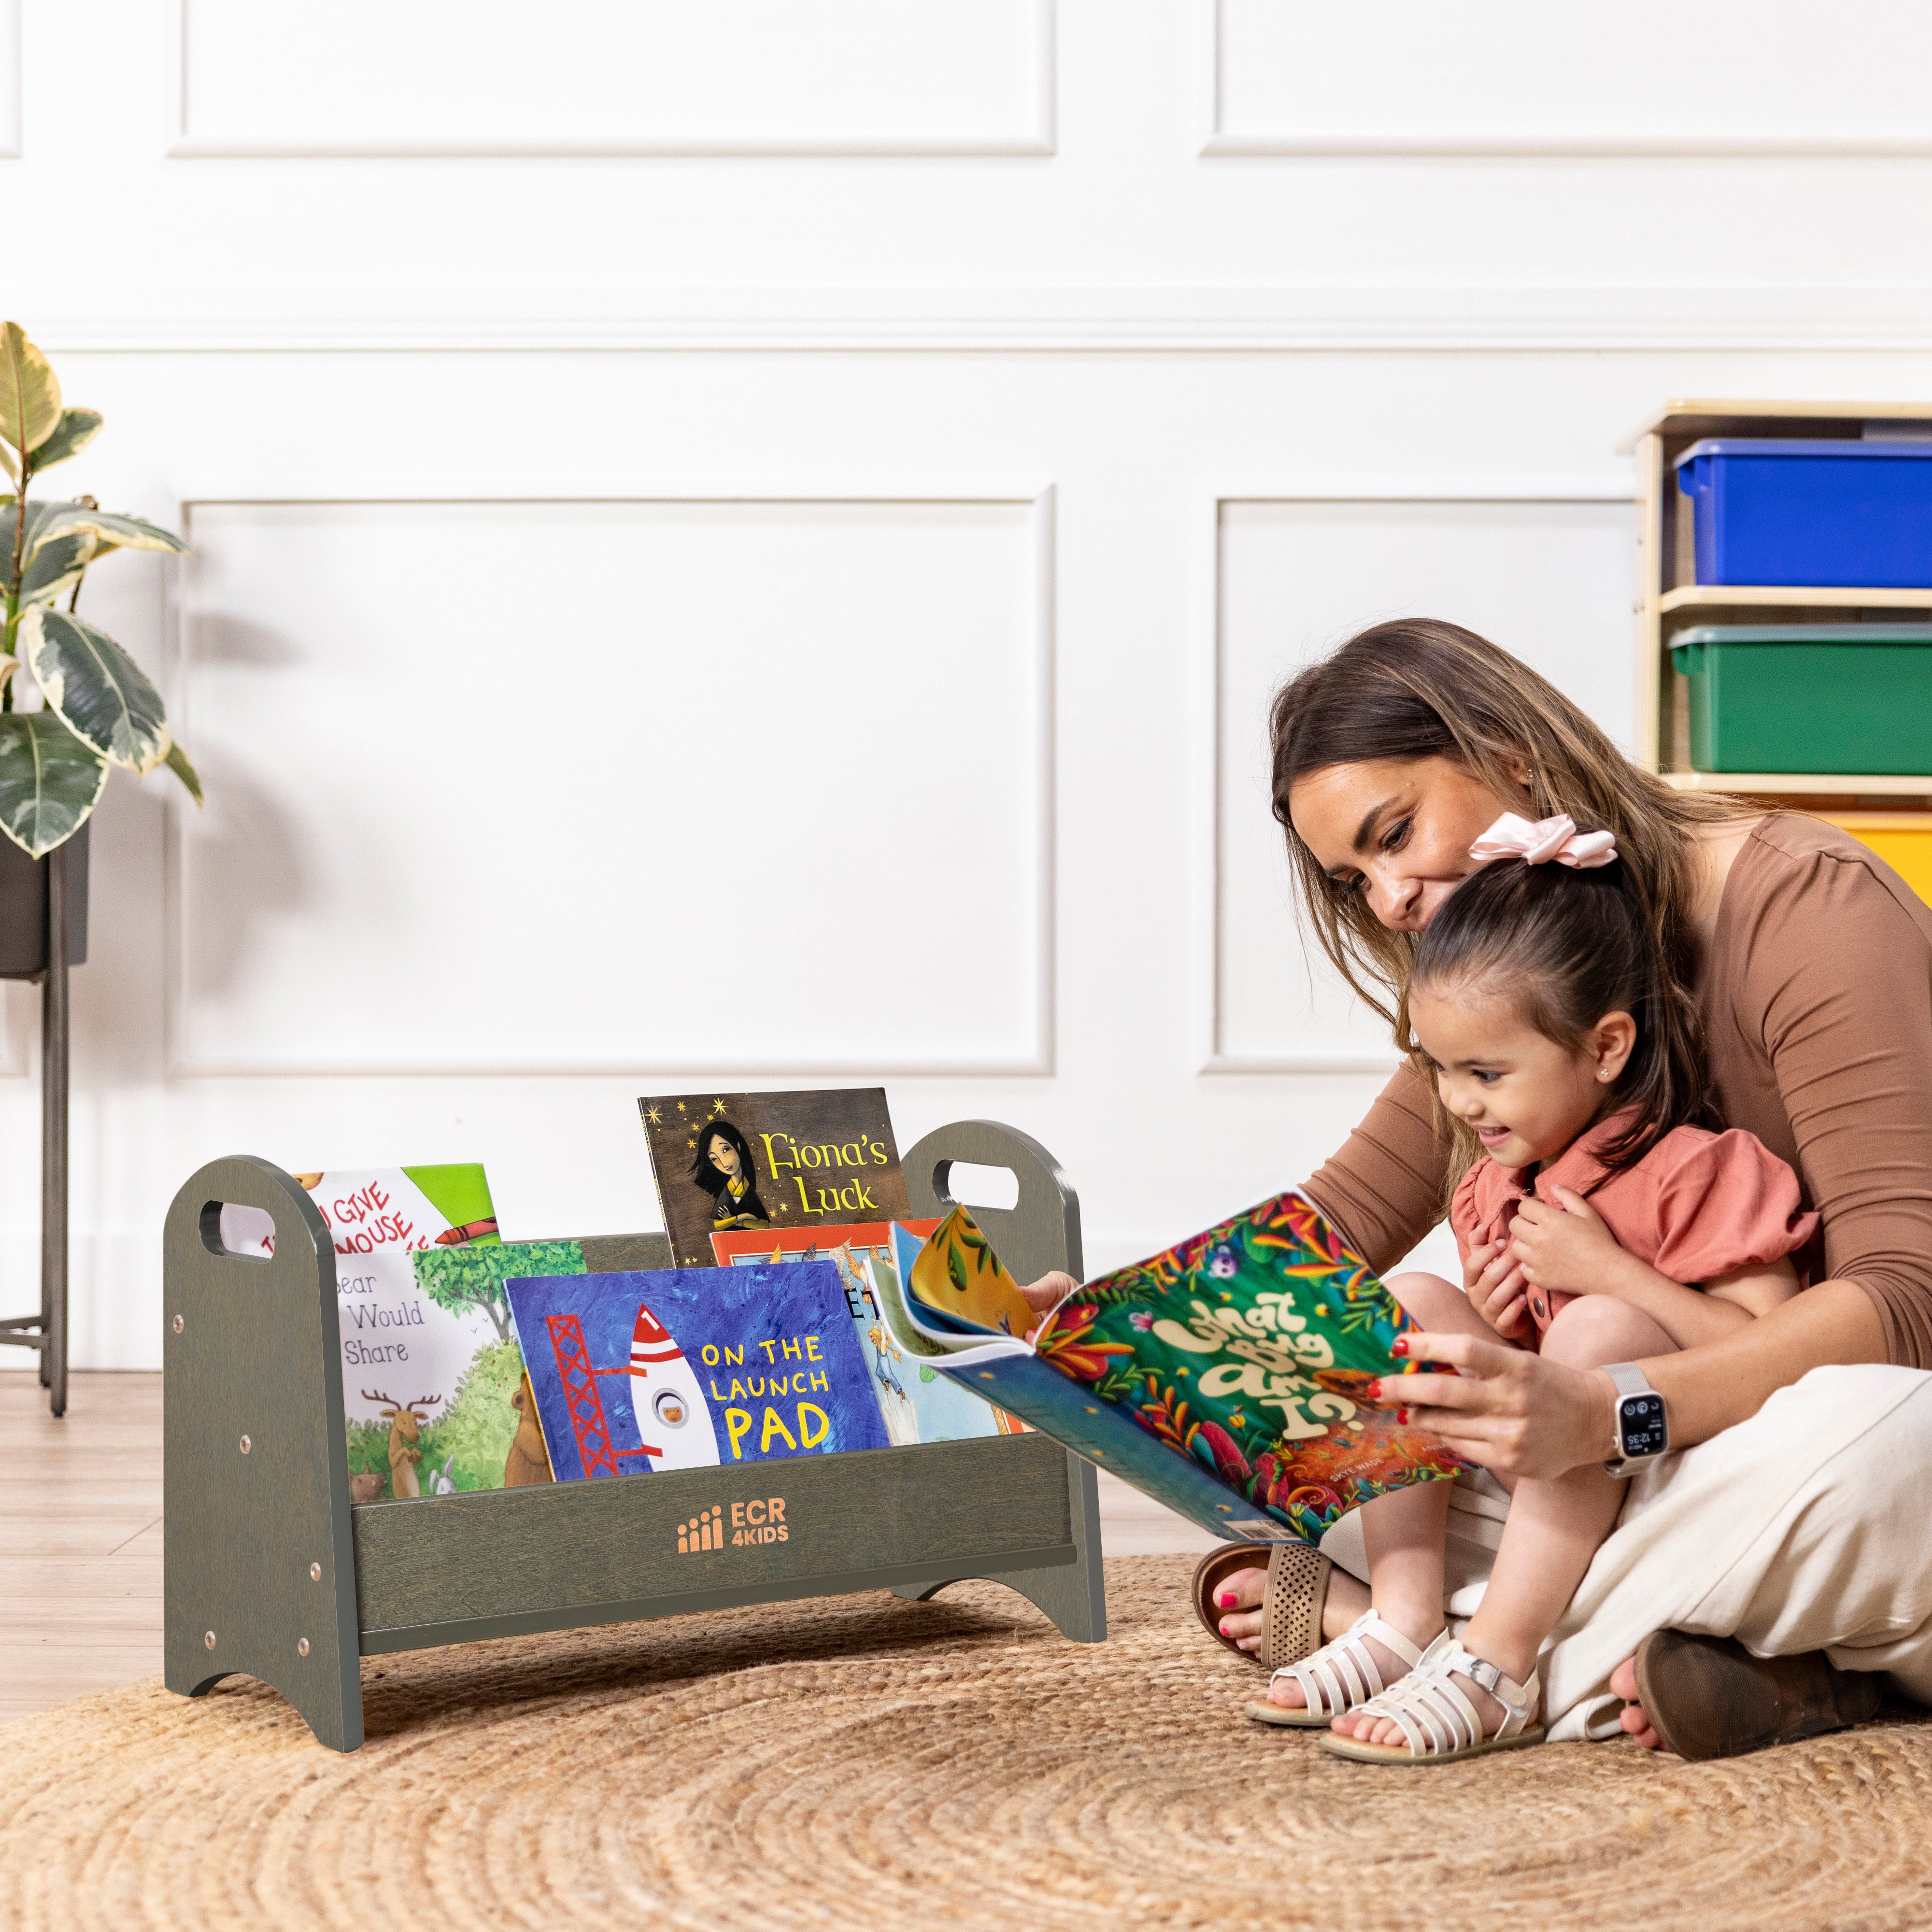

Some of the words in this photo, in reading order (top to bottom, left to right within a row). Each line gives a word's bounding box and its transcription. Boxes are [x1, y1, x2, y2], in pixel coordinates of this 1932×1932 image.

[759, 1133, 888, 1179] Fiona's
[334, 1180, 390, 1224] GIVE
[793, 1176, 879, 1217] Luck
[335, 1211, 413, 1254] MOUSE
[346, 1301, 425, 1329] Would
[641, 1310, 660, 1331] 1
[344, 1340, 409, 1364] Share
[702, 1344, 743, 1366] ON
[759, 1336, 824, 1364] THE
[710, 1370, 829, 1400] LAUNCH
[725, 1402, 829, 1460] PAD
[1627, 1433, 1651, 1445] 12:35
[1330, 1467, 1354, 1482] SKYE
[1355, 1457, 1384, 1471] WADE
[731, 1497, 786, 1527] ECR
[732, 1524, 789, 1546] 4KIDS
